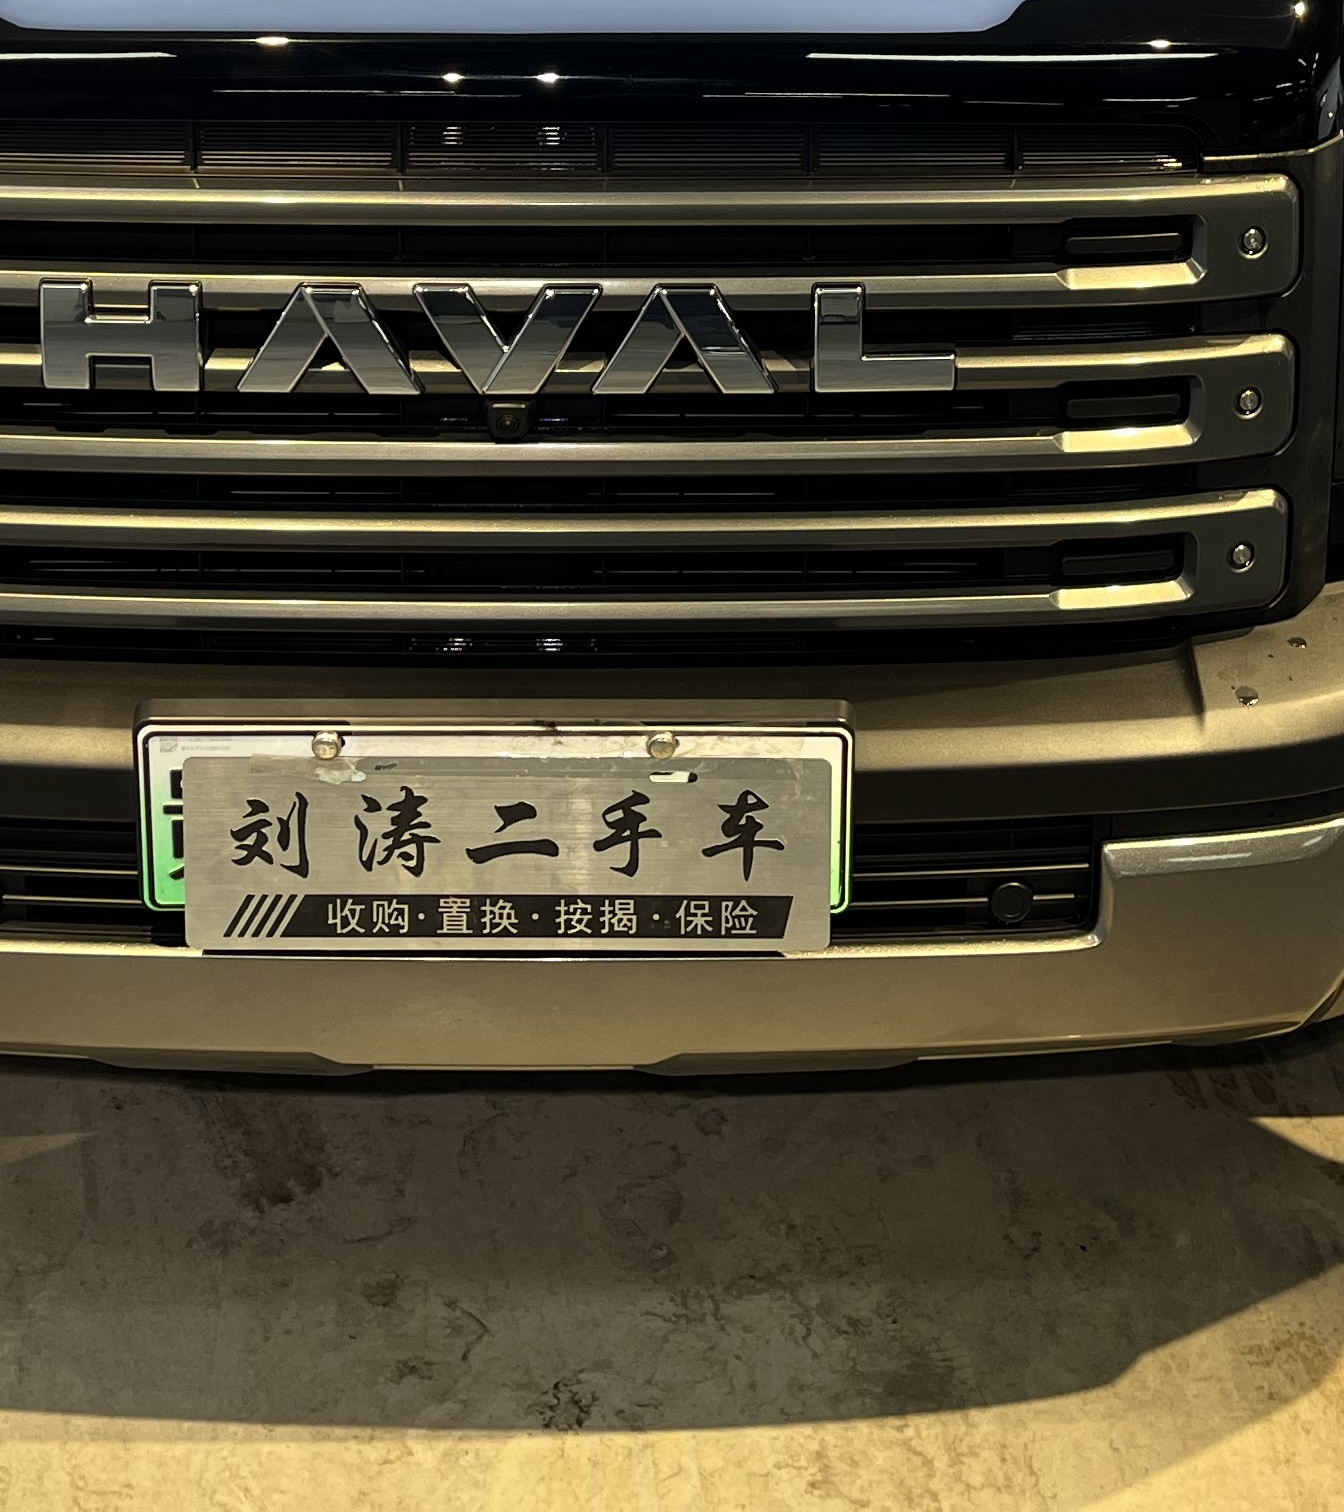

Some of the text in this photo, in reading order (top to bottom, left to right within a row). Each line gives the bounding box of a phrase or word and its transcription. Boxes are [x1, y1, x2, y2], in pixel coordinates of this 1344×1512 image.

[39, 279, 957, 395] HAVAL
[229, 785, 786, 882] 刘涛二手车
